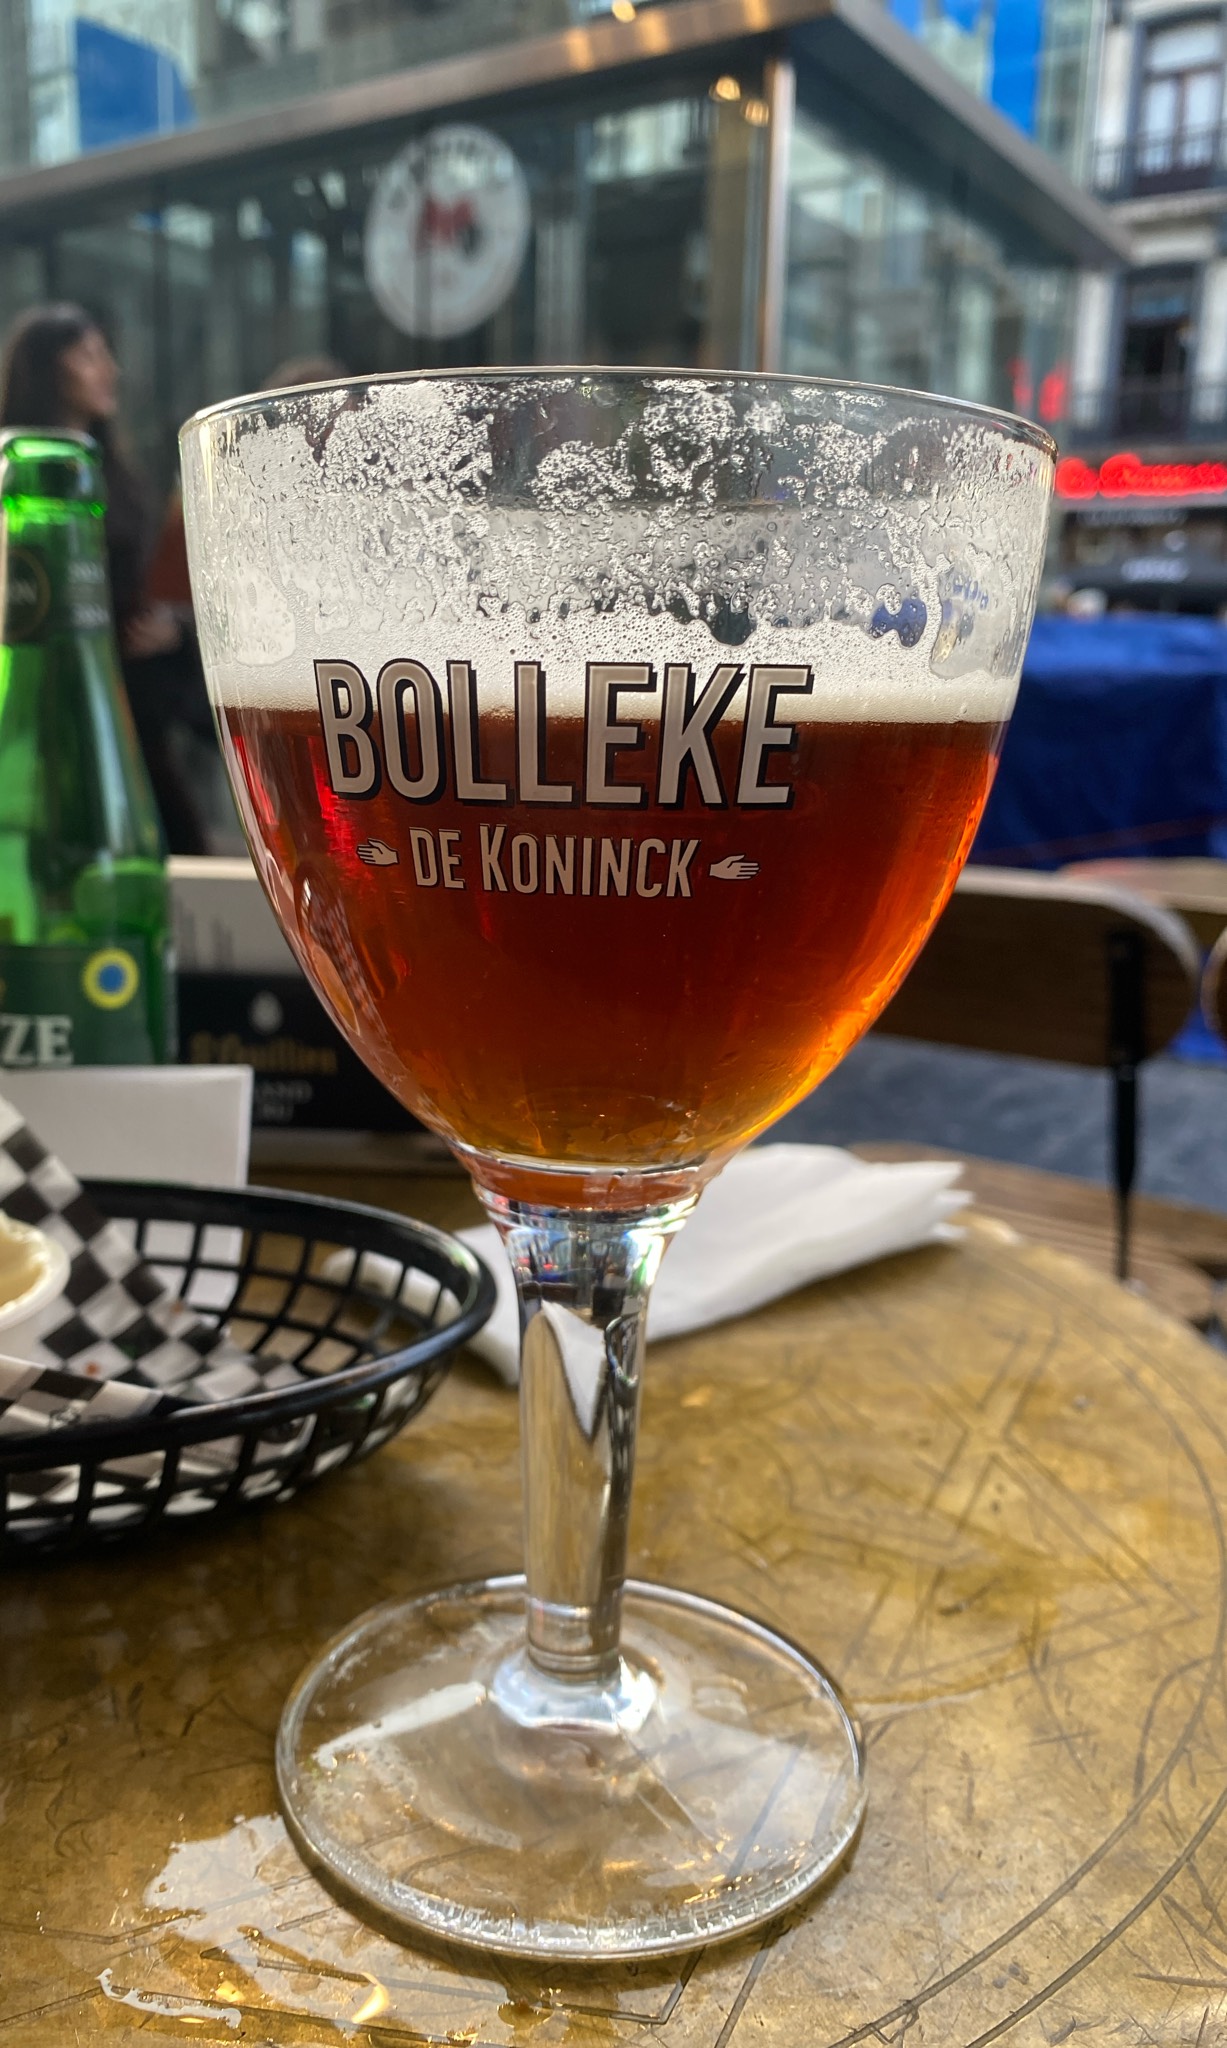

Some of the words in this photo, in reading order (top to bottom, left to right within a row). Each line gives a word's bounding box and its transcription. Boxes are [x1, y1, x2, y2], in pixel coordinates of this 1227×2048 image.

[314, 659, 813, 809] BOLLEKE
[409, 827, 466, 890] DE
[480, 823, 700, 898] KONINCK
